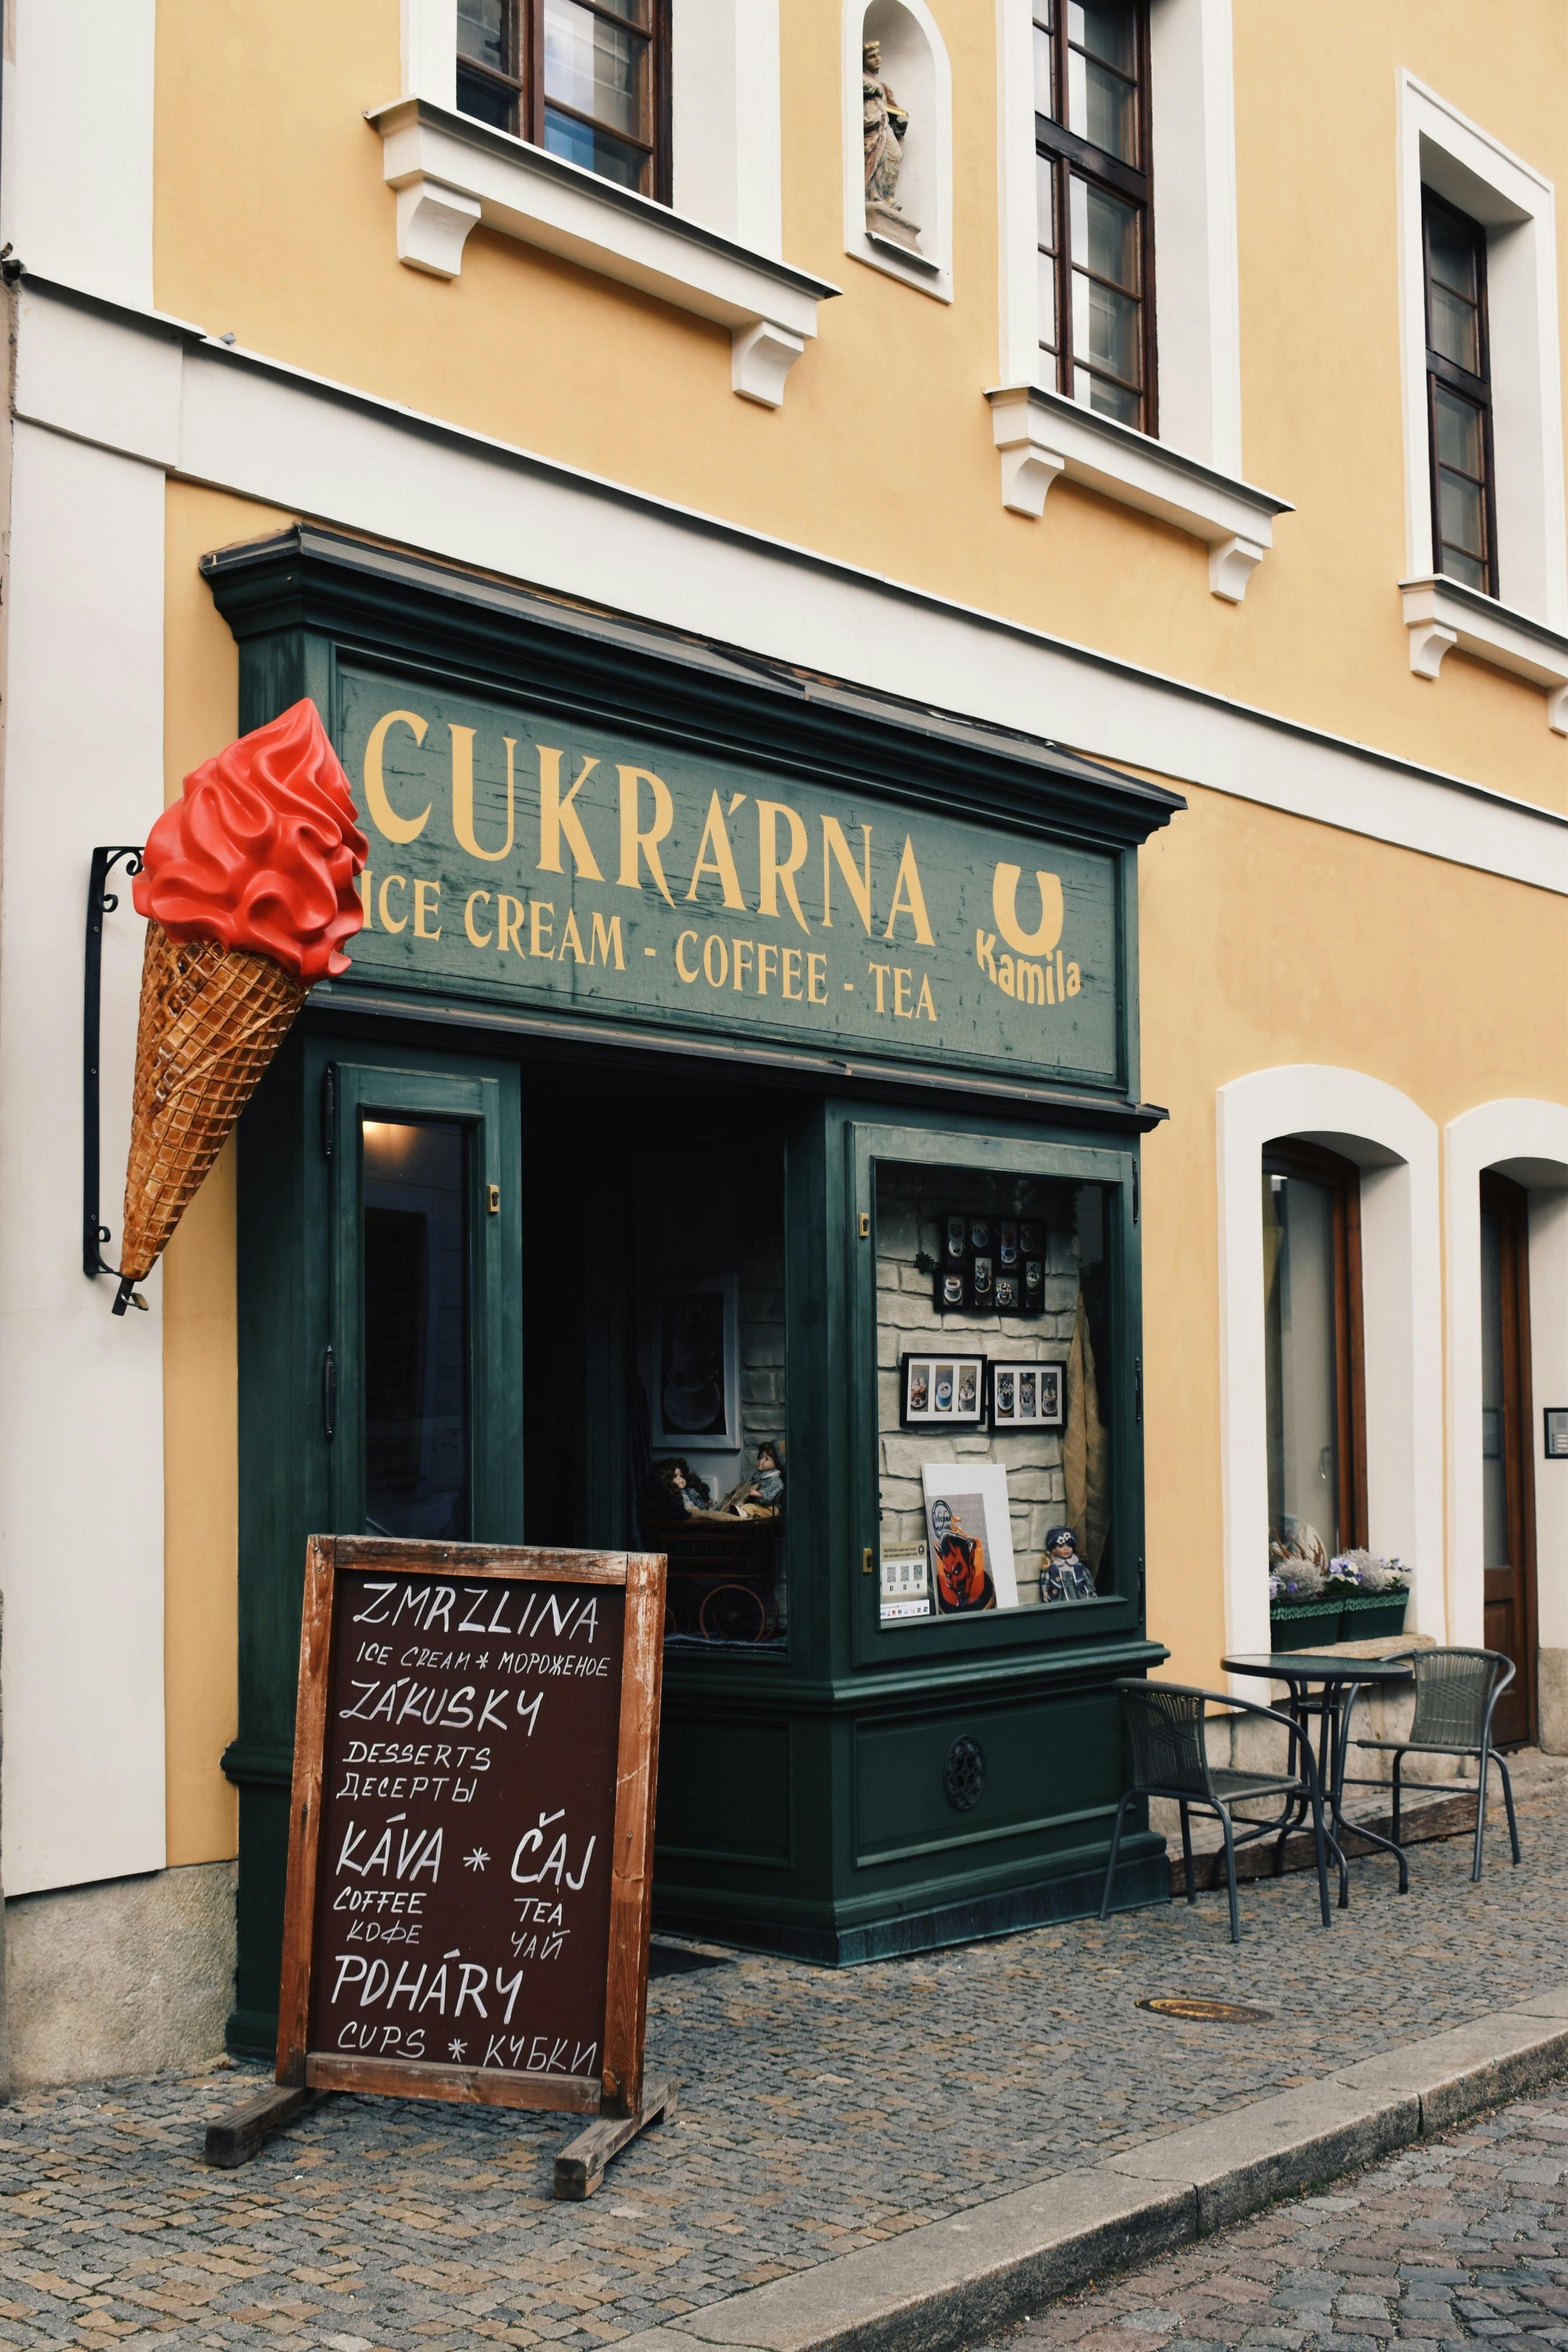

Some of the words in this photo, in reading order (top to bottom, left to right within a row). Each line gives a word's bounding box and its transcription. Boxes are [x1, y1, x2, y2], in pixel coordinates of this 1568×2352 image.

[363, 709, 937, 947] CUKRÁRNA
[361, 870, 442, 942] ICE
[464, 890, 626, 971] CREAM
[676, 929, 828, 1006] COFFEE
[868, 961, 937, 1022] TEA
[975, 928, 1082, 1005] Kamila
[352, 1582, 599, 1644] ZMRZLINA
[356, 1641, 393, 1665] ICE
[400, 1646, 471, 1671] CREAM
[498, 1651, 611, 1678] МОРОЖЕНОЕ
[339, 1676, 544, 1737] ZÁKUSKY
[342, 1741, 491, 1771] DESSERTS
[335, 1772, 478, 1803] ДЕСЕРТЫ
[335, 1812, 444, 1884] KÁVA
[510, 1808, 597, 1891] ČAJ
[332, 1886, 428, 1915] COFFEE
[514, 1898, 563, 1926] TEA
[346, 1919, 423, 1945] КОФЕ
[510, 1929, 570, 1960] ЧАЙ
[331, 1948, 524, 2025] POHÁRY
[337, 2021, 426, 2059] CUPS
[482, 2034, 598, 2077] КУБКИ
